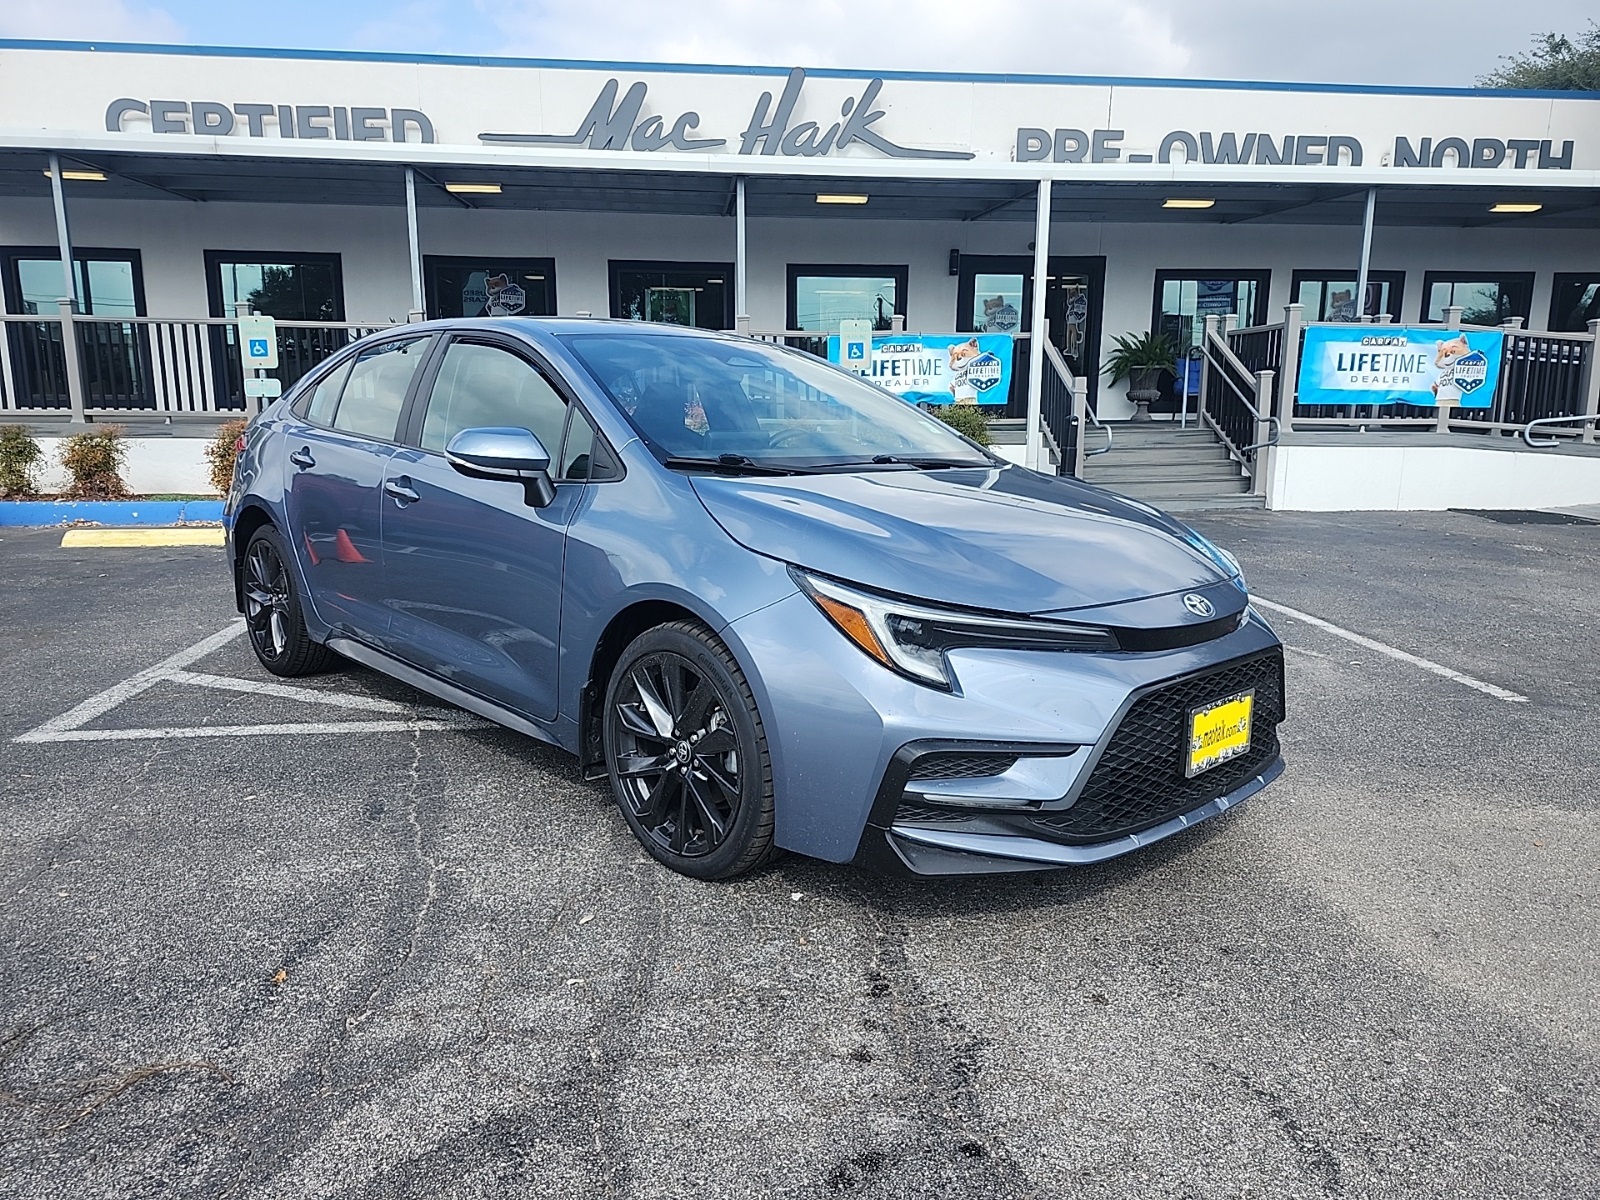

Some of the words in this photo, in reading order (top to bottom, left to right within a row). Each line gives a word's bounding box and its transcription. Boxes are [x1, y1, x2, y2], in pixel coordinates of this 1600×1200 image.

[105, 98, 434, 144] CERTIFIED
[478, 78, 727, 151] Mac
[740, 67, 977, 160] Haik
[1015, 128, 1363, 167] PRE-OWNED
[1393, 136, 1575, 170] NORTH
[881, 344, 923, 353] CARFAX
[1361, 336, 1408, 347] CARFAX
[860, 358, 942, 377] LIFETIME
[1337, 353, 1428, 373] LIFETIME
[1455, 366, 1485, 375] LIFETIME
[874, 379, 930, 387] DEALER
[1350, 375, 1410, 384] DEALER
